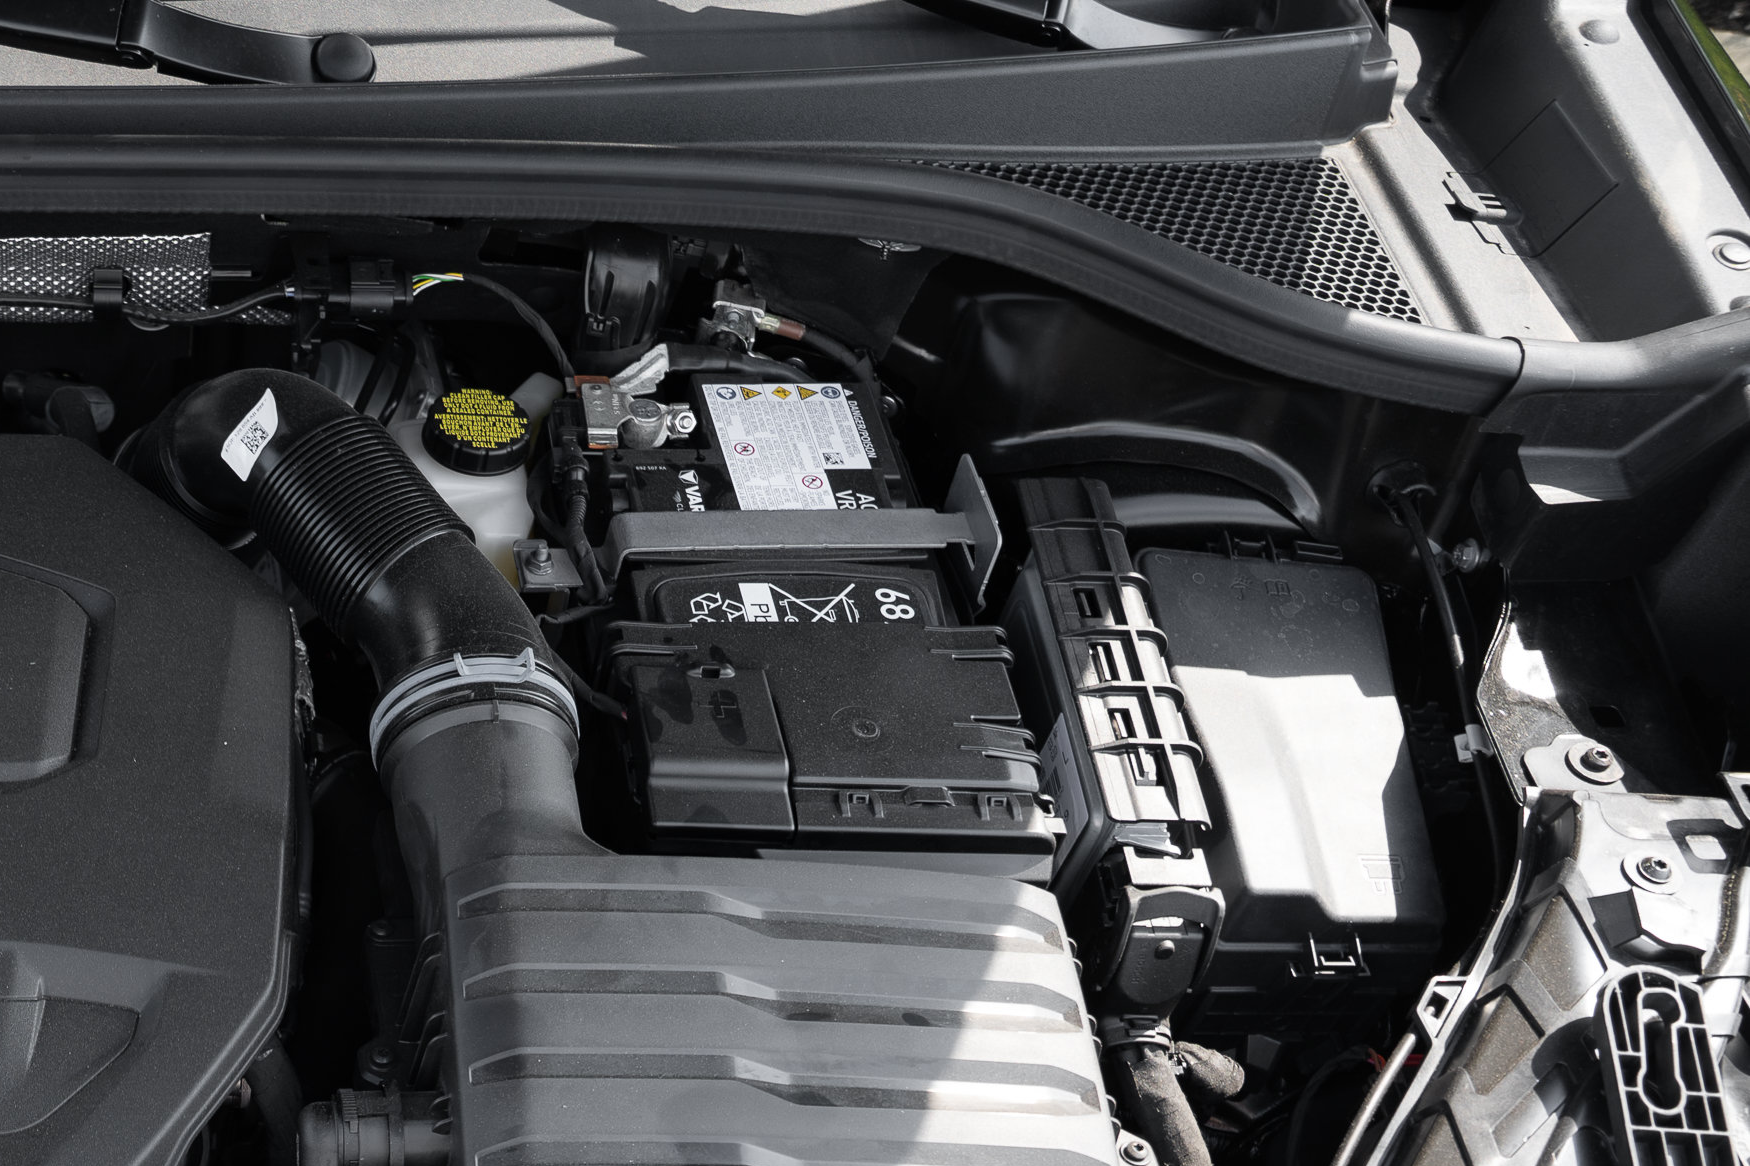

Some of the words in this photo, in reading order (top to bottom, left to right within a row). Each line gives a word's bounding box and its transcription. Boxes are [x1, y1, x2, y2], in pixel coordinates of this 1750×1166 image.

[847, 400, 877, 457] DANGER/POISON
[684, 486, 706, 512] VAR
[836, 490, 857, 510] VR
[856, 492, 878, 510] AG
[875, 588, 915, 620] 68
